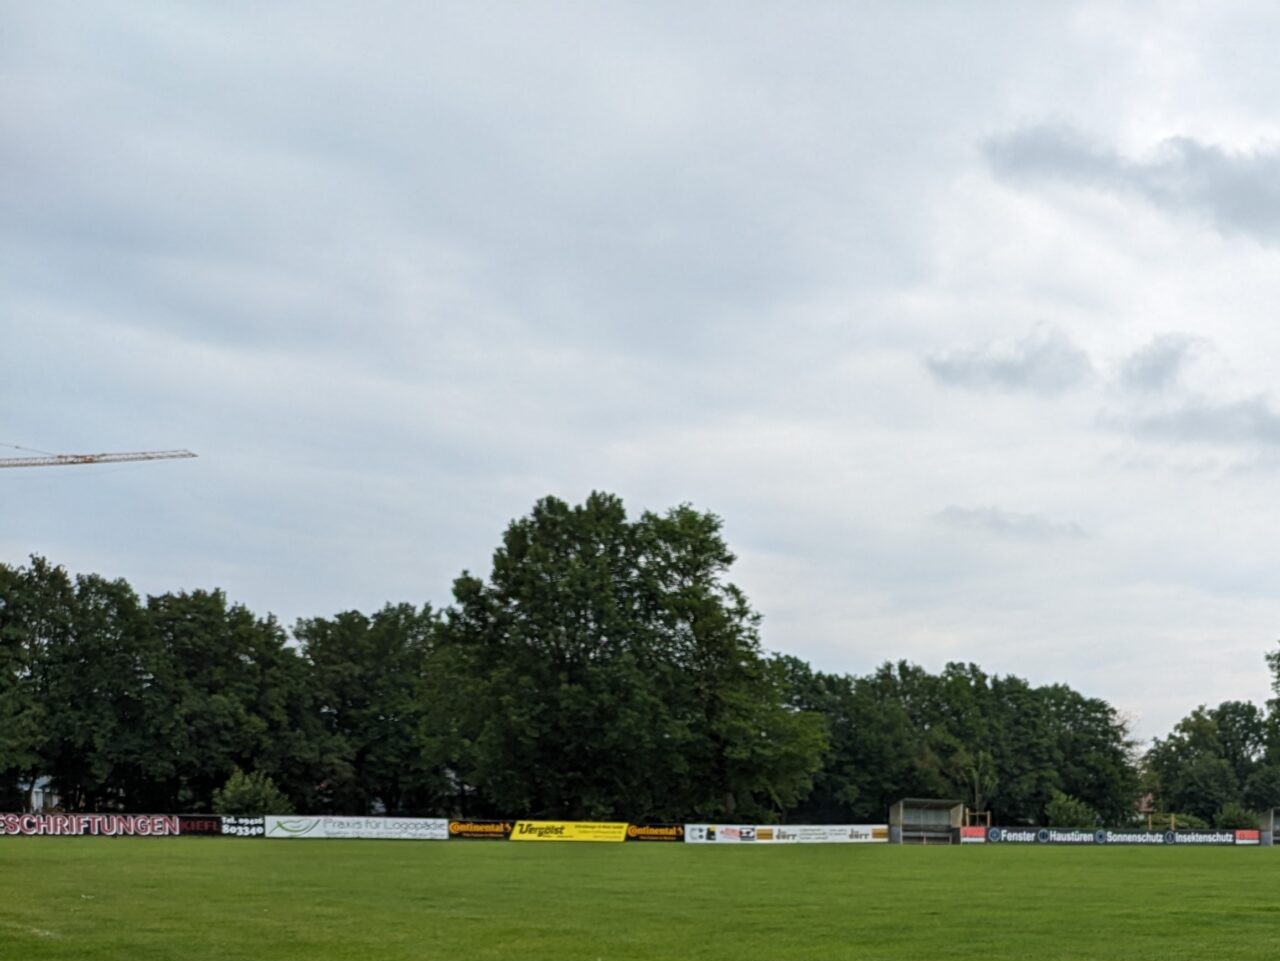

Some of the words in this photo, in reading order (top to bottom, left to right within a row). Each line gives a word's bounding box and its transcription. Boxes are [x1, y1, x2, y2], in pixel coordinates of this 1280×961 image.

[221, 824, 264, 836] 803340
[449, 822, 503, 834] Continental
[628, 825, 676, 837] Continental
[1001, 830, 1036, 842] Fenster
[1049, 830, 1094, 842] Haustüren
[1106, 831, 1164, 843] Sonnenschutz
[1175, 831, 1233, 843] Insektenschutz
